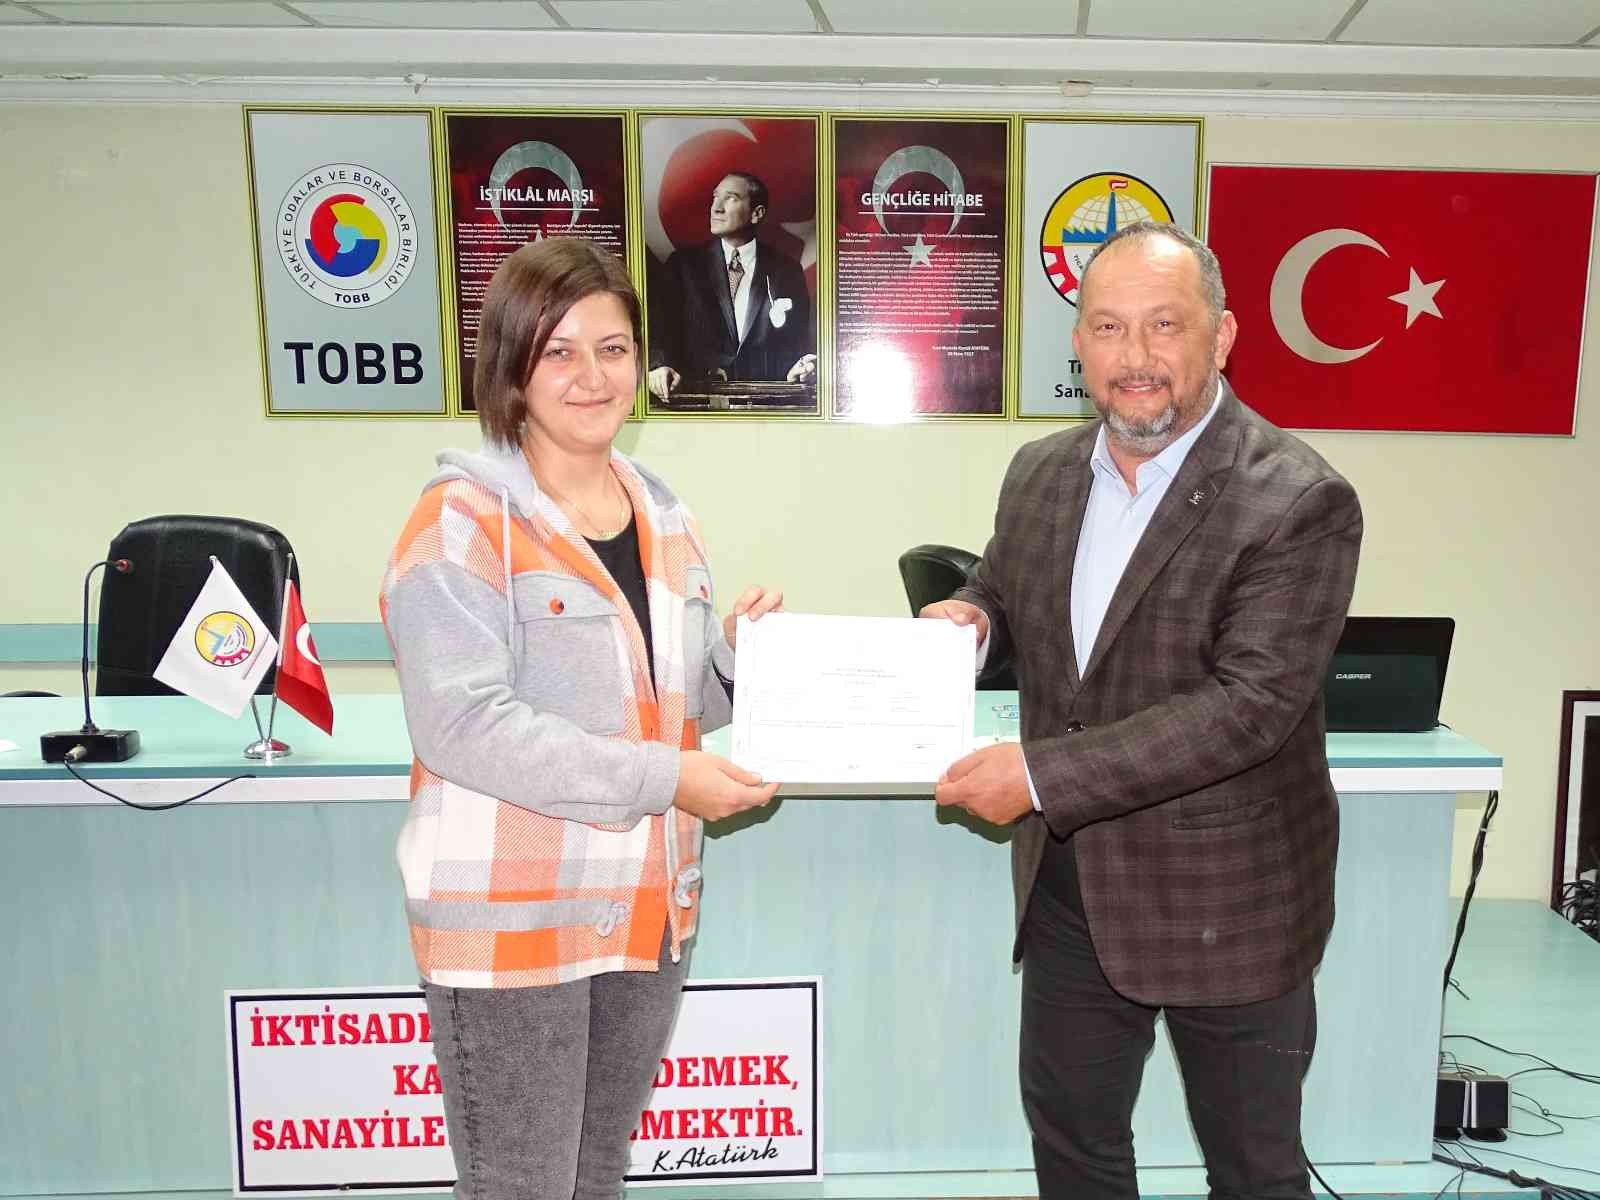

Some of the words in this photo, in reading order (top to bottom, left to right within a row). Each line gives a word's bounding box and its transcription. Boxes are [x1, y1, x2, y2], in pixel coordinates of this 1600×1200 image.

[284, 175, 324, 222] ODALAR
[328, 170, 347, 181] VE
[353, 172, 410, 232] BORSALAR
[480, 185, 544, 202] İSTİKLÂL
[547, 188, 594, 206] MARŞI
[861, 190, 931, 209] GENÇLİĞE
[933, 190, 983, 207] HİTABE
[334, 292, 371, 304] TOBB
[284, 342, 424, 385] TOBB
[630, 1099, 803, 1141] MEKTİR.
